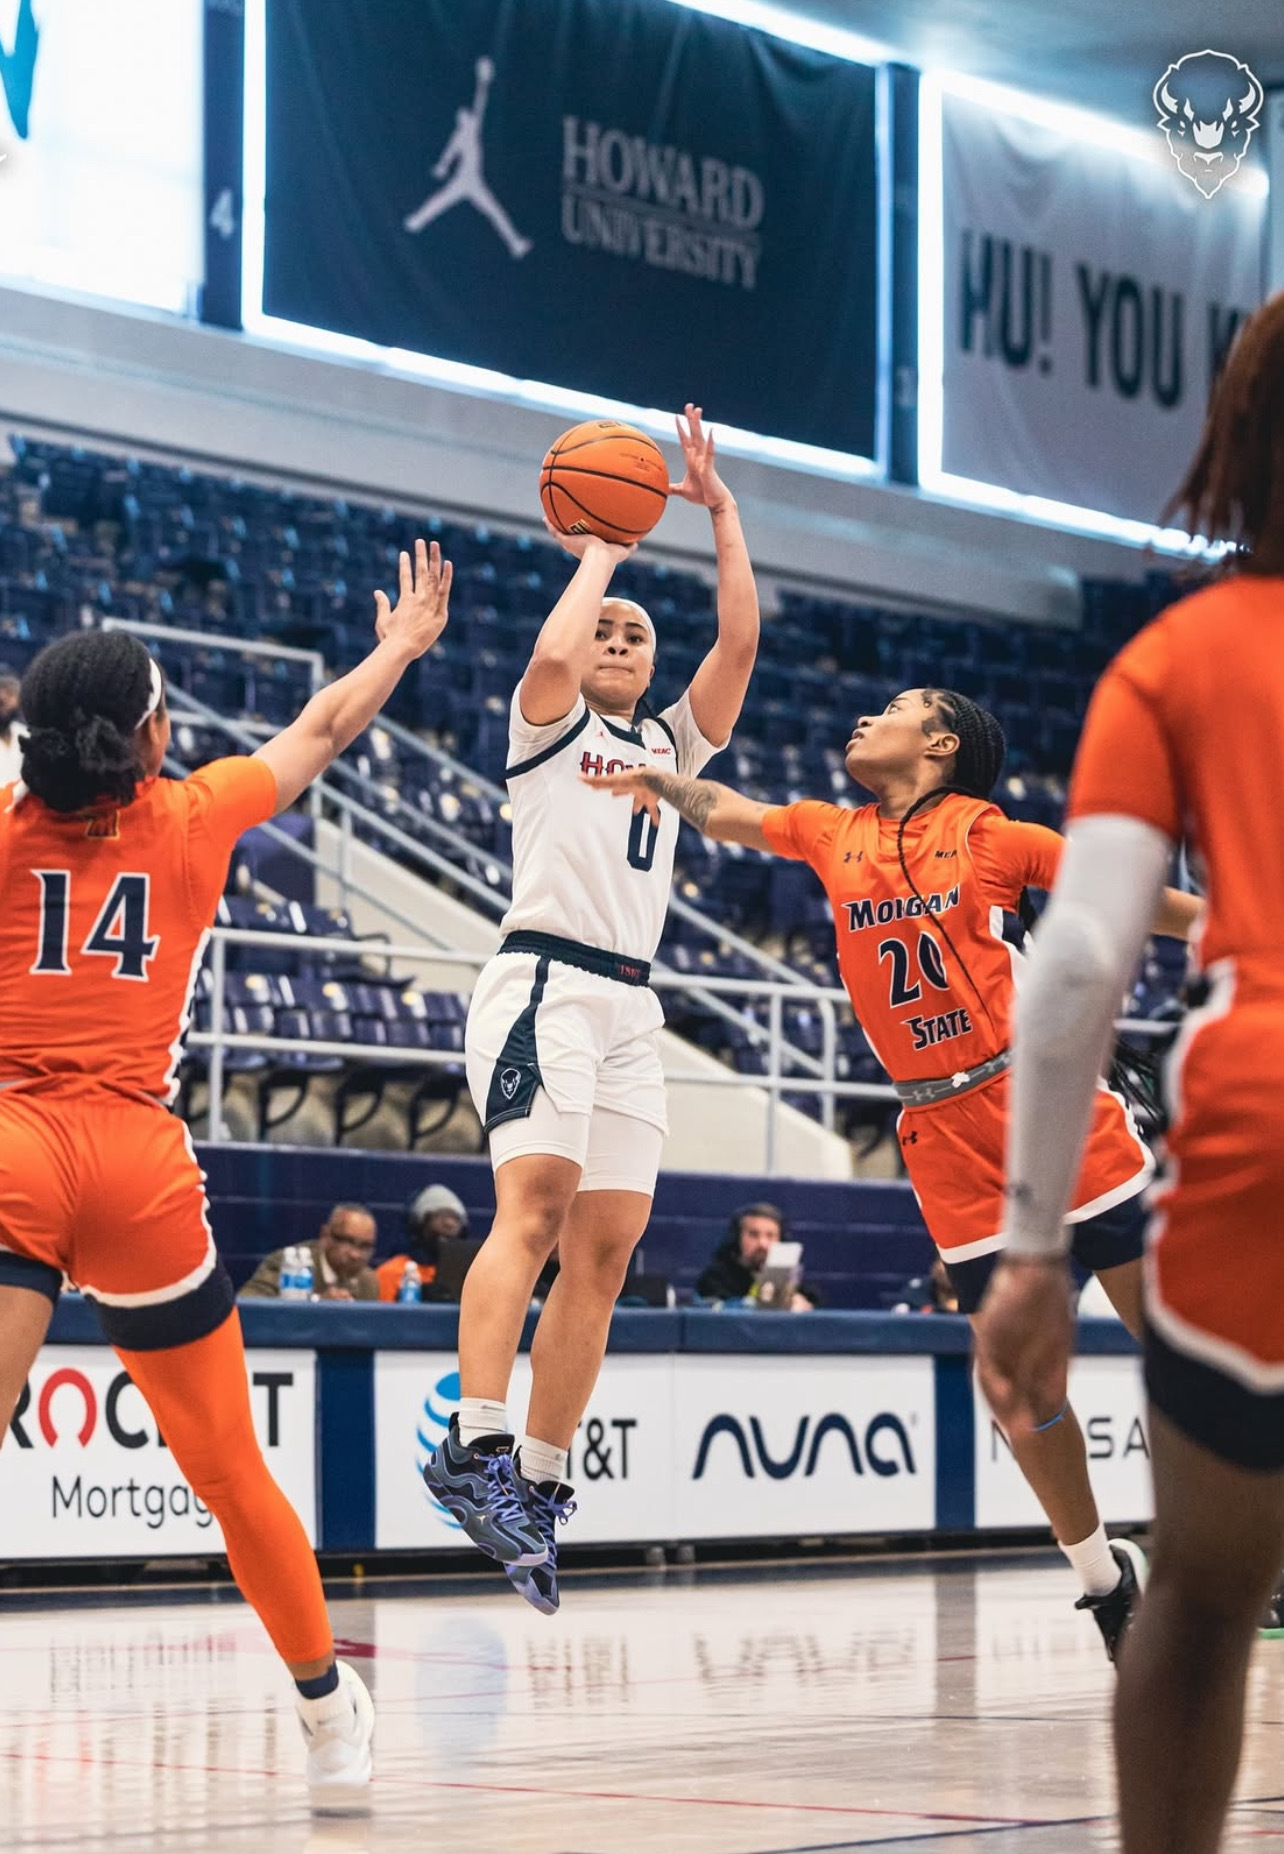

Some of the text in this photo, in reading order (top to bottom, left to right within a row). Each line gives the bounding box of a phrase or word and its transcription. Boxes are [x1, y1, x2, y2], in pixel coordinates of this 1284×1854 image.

[563, 115, 764, 231] HOWARD
[561, 192, 760, 290] UNIVERSITY
[961, 228, 1052, 375] HU!
[1077, 260, 1183, 411] YOU
[30, 869, 161, 982] 14
[878, 931, 950, 1009] 20
[901, 1008, 973, 1051] STATE
